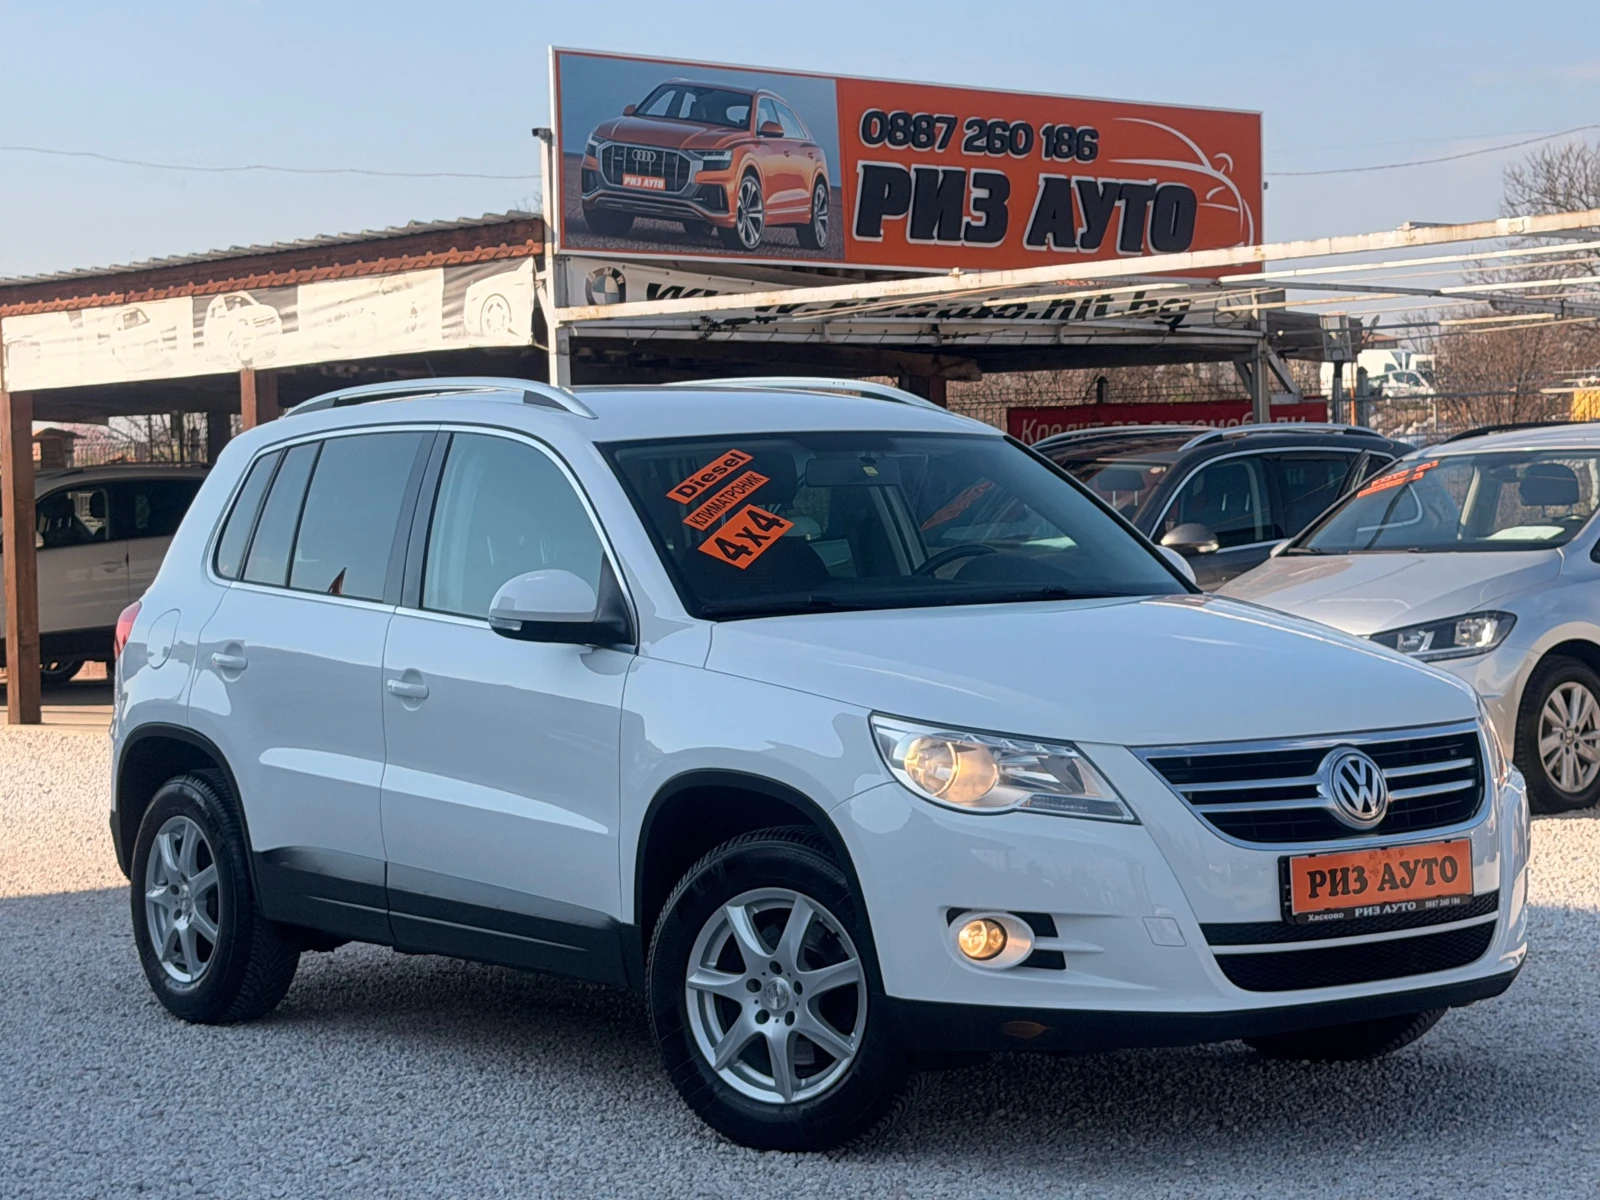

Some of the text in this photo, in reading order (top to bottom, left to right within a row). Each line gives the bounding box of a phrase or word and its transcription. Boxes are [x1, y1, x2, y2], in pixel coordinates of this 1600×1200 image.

[860, 108, 1099, 163] 0887 260 186
[853, 160, 1198, 256] РИЗ АУТО
[675, 452, 746, 498] Diesel
[690, 473, 763, 527] КЛИМАТРОНИК
[1307, 855, 1458, 898] РИЗ АУТО
[1308, 911, 1345, 922] Хасково
[1354, 906, 1380, 917] РИЗ
[1382, 901, 1417, 915] АУТО
